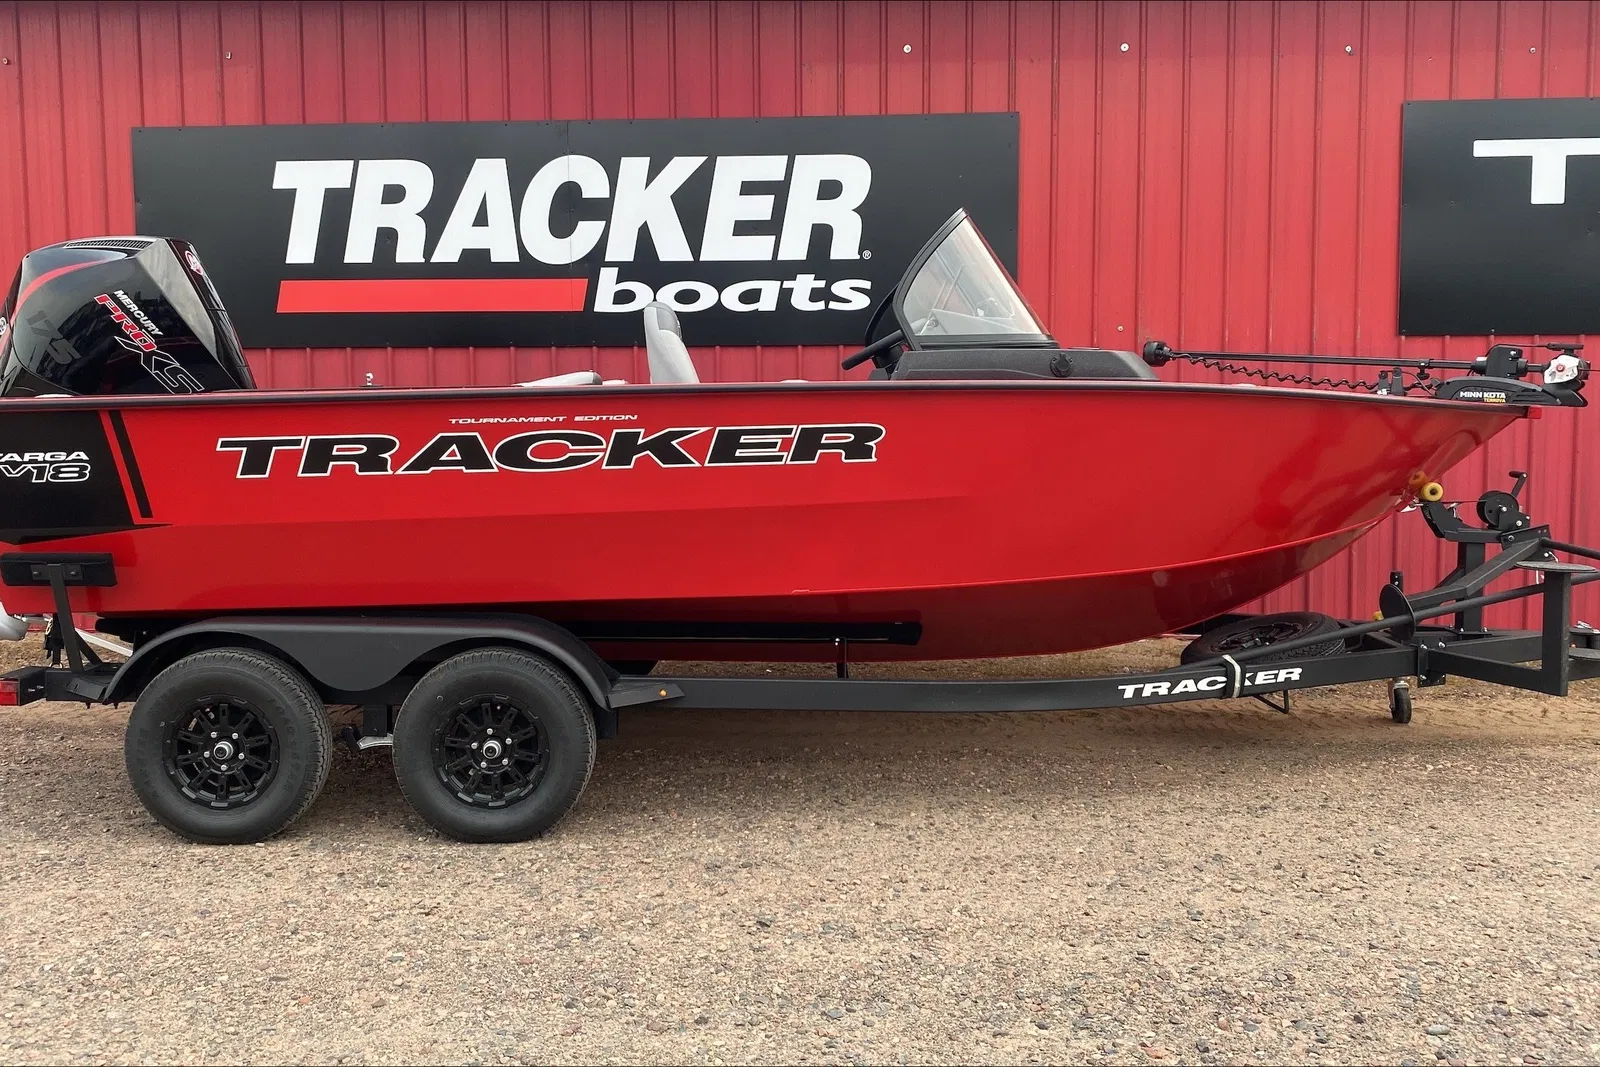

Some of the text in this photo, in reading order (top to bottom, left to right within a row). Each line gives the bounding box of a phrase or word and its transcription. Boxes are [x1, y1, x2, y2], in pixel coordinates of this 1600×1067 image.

[272, 154, 872, 264] TRACKER
[114, 290, 163, 335] MERCURY
[593, 267, 872, 313] boats
[94, 294, 157, 351] PRO
[114, 329, 205, 394] XS
[1483, 391, 1506, 399] KOTA
[449, 414, 638, 424] TOURNAMENT EDITION
[0, 451, 90, 462] ARGA
[215, 423, 887, 480] TRACKER
